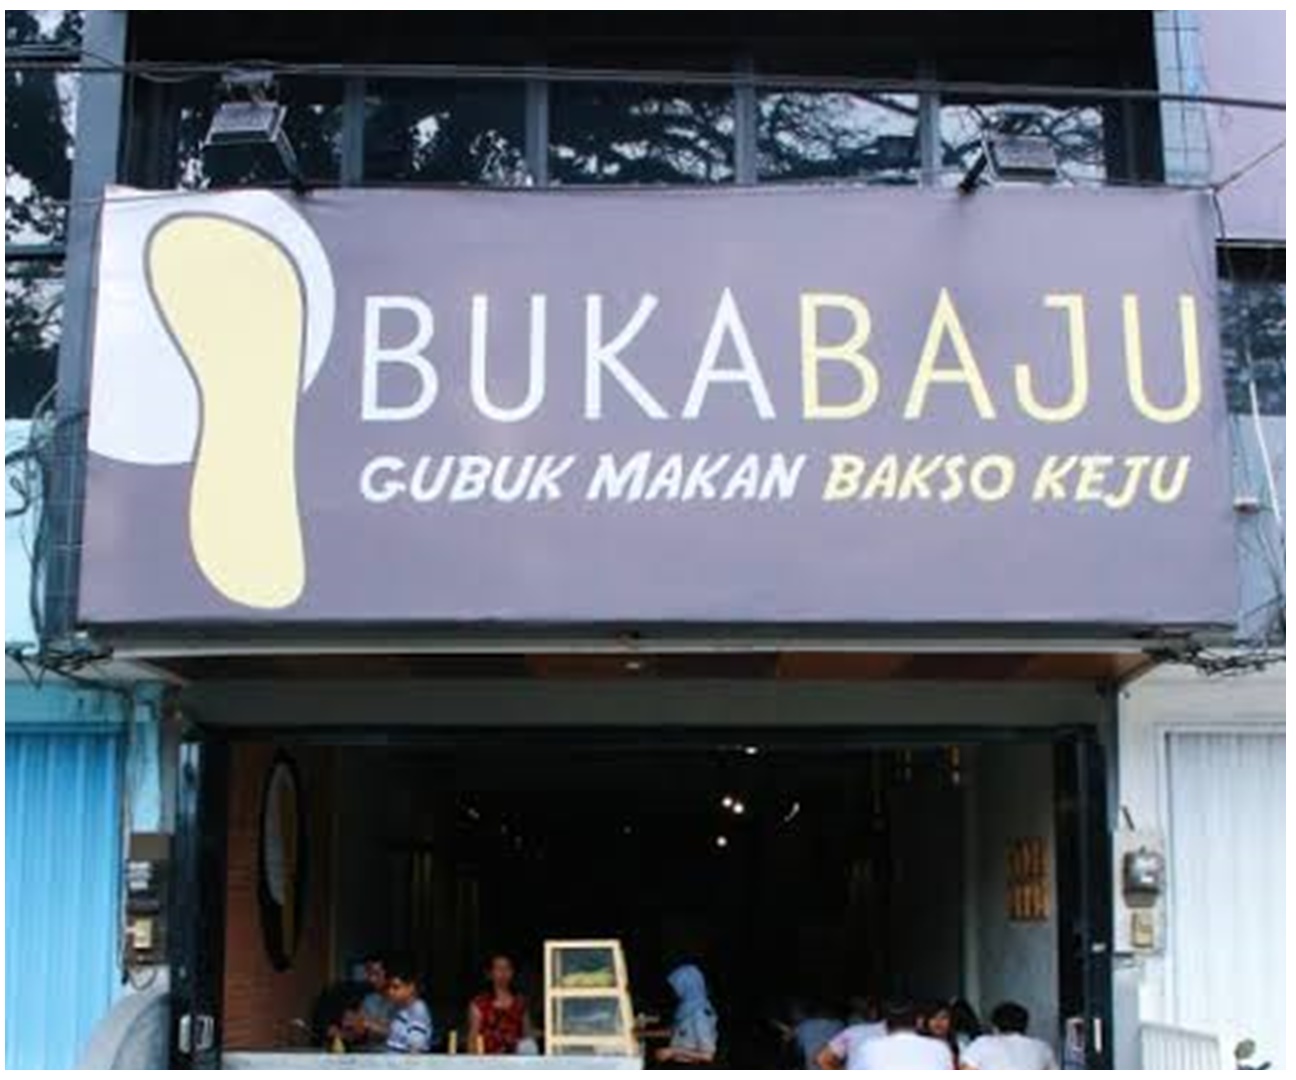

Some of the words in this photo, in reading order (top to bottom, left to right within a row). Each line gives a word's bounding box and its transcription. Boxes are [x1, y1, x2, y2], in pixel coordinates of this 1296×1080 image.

[360, 454, 576, 502] GUBUK
[585, 451, 807, 502] MAKAN
[822, 454, 1016, 501] BAKSO
[1030, 453, 1192, 508] KEJU
